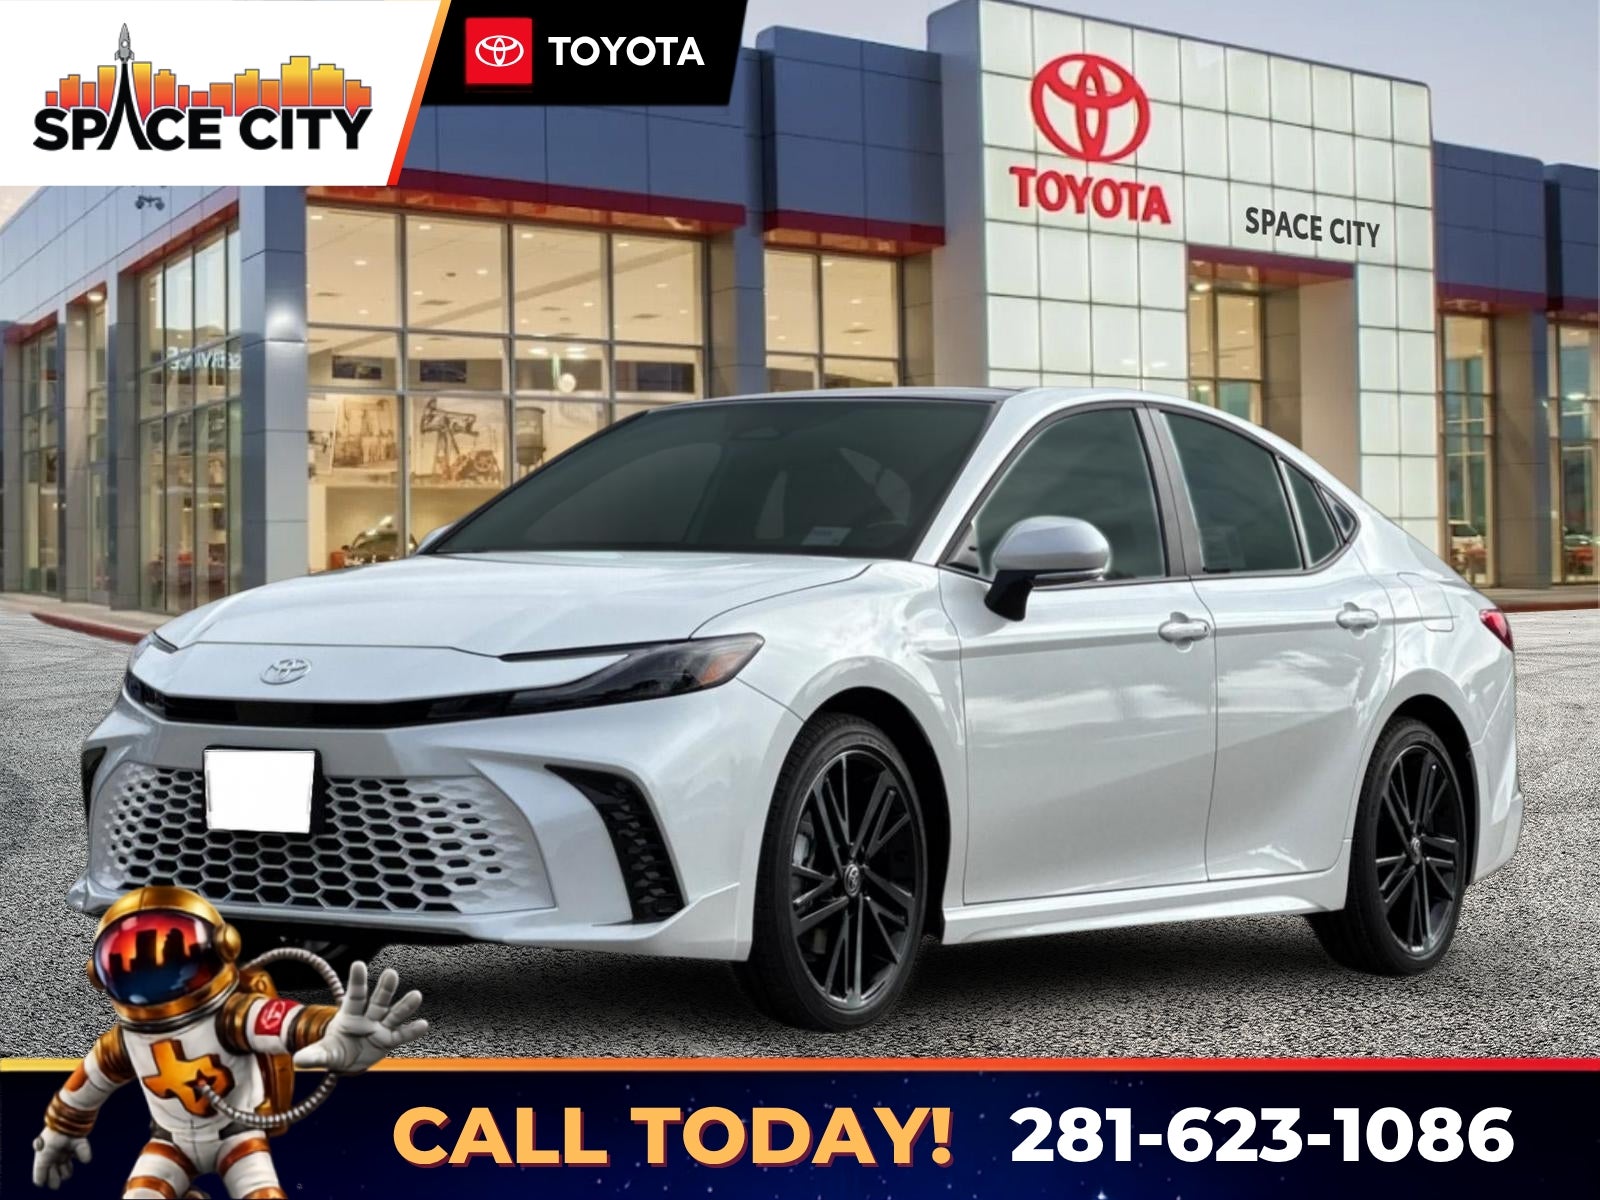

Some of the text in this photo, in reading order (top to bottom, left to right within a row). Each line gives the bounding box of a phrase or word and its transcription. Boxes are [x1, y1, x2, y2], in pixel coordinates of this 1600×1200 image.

[1009, 166, 1171, 224] TOYOTA
[1245, 206, 1380, 248] SPACE CITY
